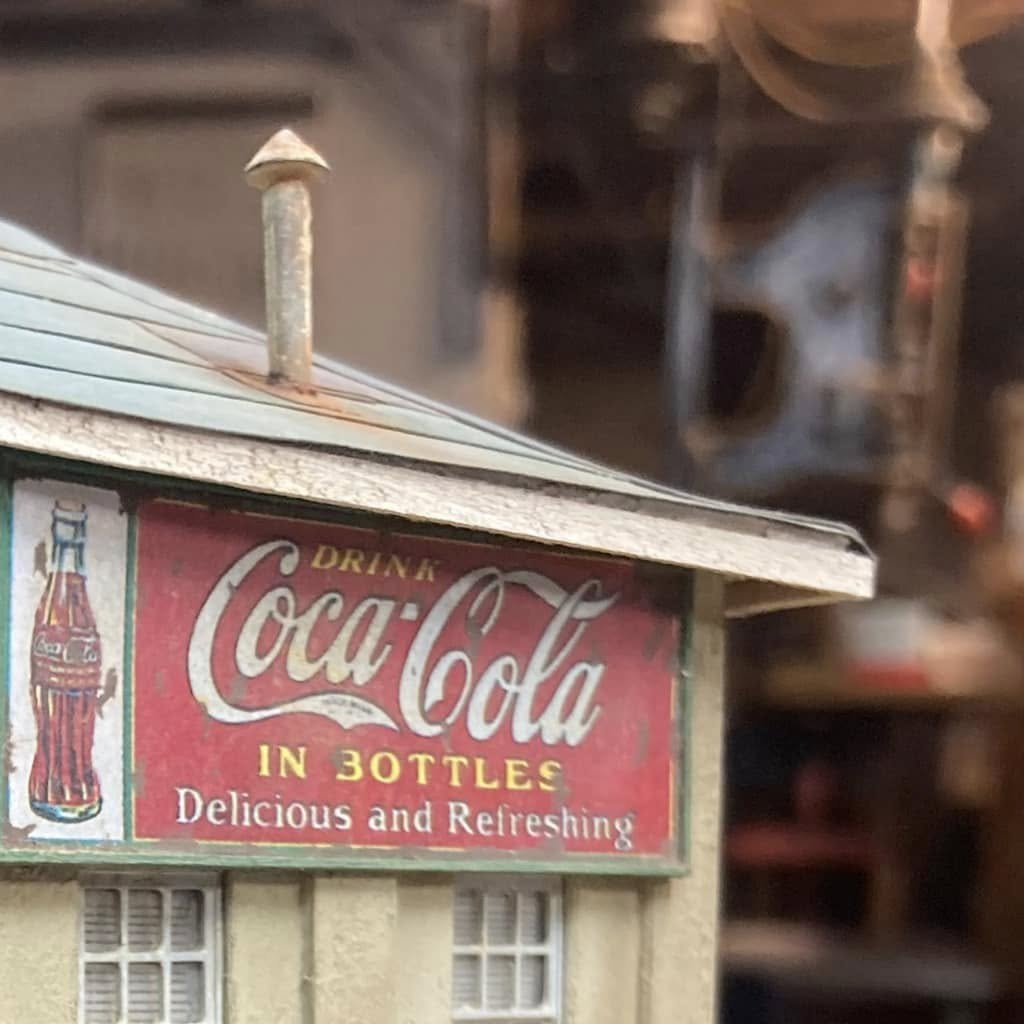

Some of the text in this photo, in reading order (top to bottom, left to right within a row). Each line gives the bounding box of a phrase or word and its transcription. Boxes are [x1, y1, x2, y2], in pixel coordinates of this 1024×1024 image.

[311, 545, 443, 582] DRINK
[187, 540, 622, 747] Coca-Cola
[258, 744, 565, 791] IN BOTTLES
[175, 787, 635, 851] Delicious and Refreshing
